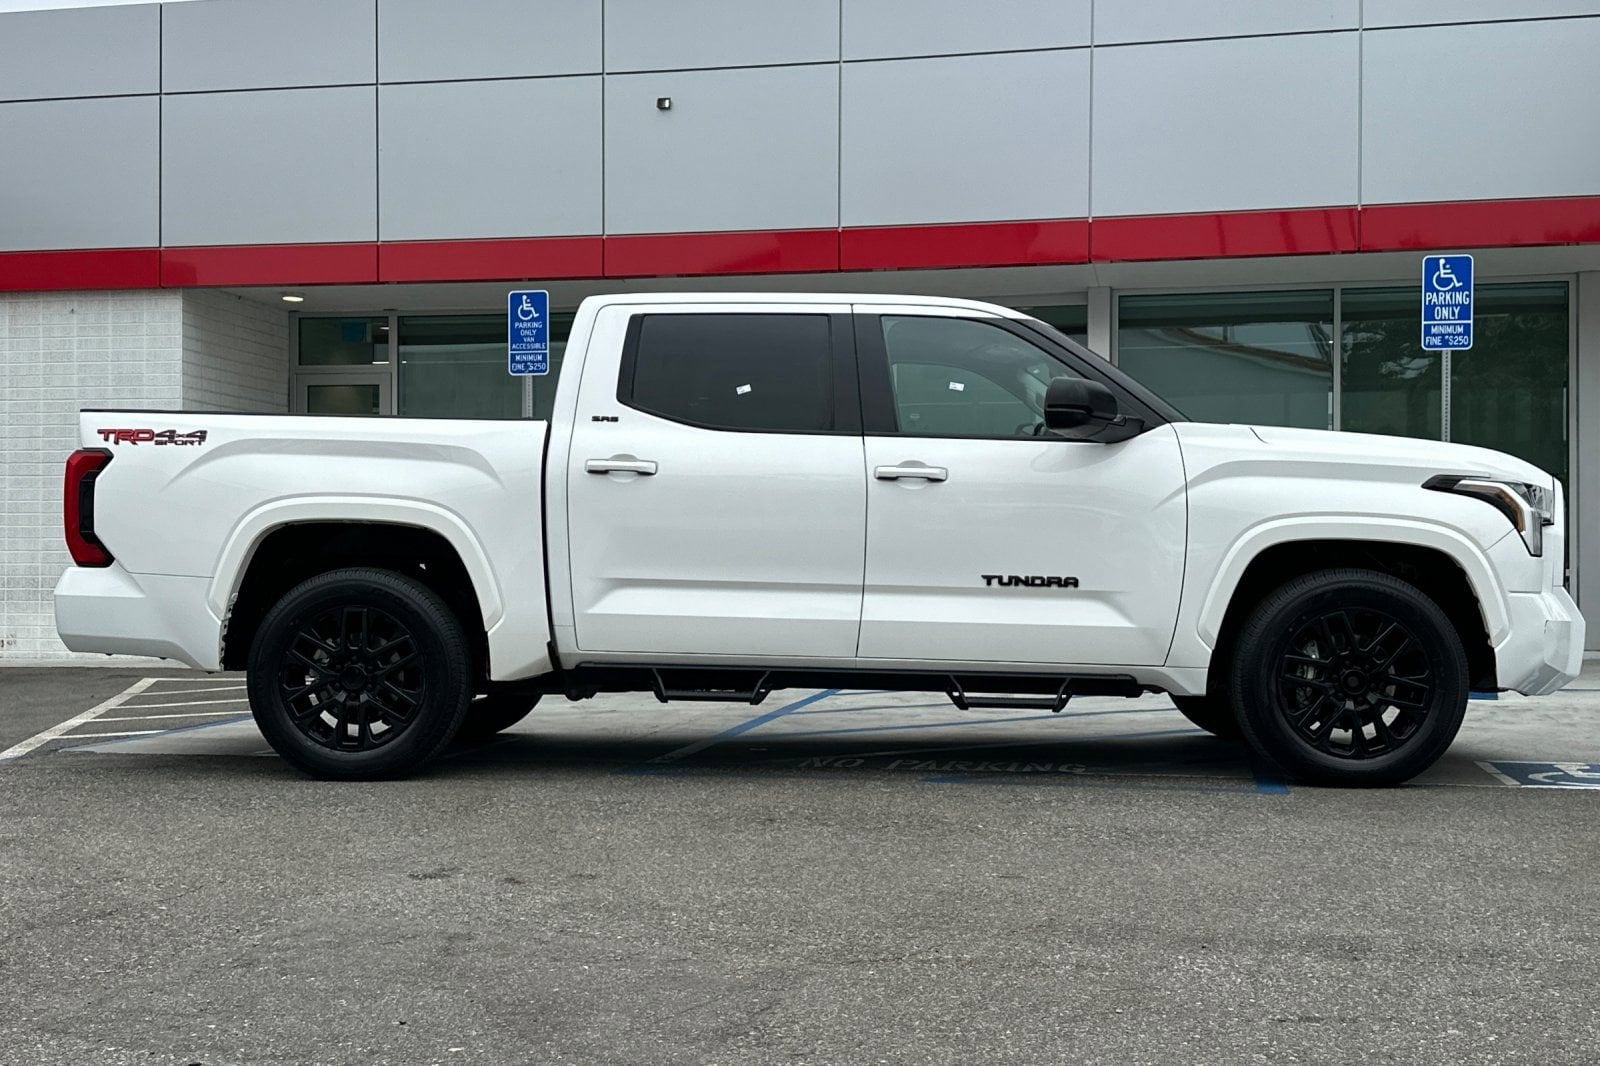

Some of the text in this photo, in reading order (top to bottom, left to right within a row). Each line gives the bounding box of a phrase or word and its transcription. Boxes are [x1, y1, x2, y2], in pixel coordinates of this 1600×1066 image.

[1426, 291, 1469, 305] PARKING
[1435, 306, 1460, 320] ONLY
[1431, 325, 1463, 334] MINIMUM
[1425, 336, 1442, 346] FINE
[97, 429, 155, 445] TRD
[981, 575, 1079, 588] TUNDRA
[799, 758, 1087, 774] NO PARKING
